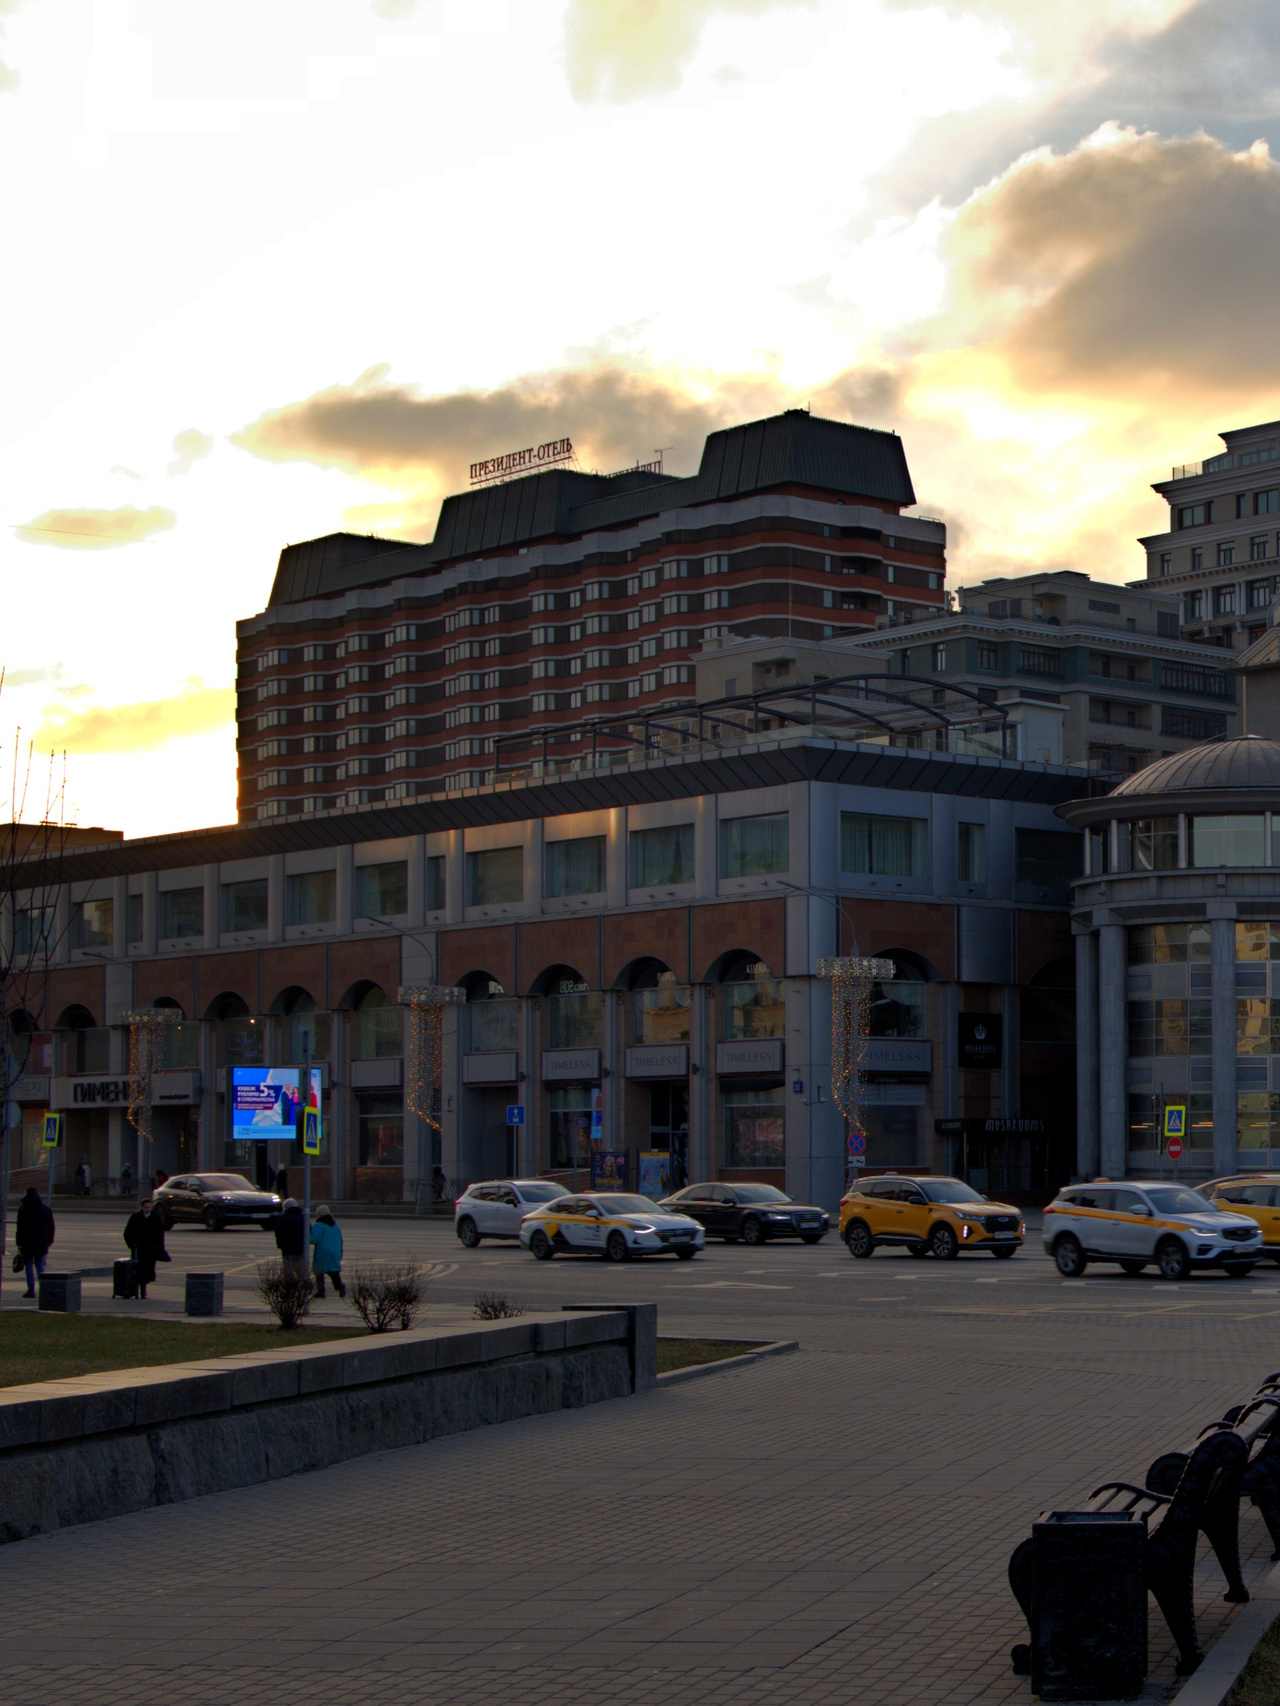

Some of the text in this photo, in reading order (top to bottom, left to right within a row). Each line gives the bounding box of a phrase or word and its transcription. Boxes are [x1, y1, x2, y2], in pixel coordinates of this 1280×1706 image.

[470, 437, 573, 479] ПРЕЗИДЕНТ-ОТЕЛЬ
[574, 982, 590, 992] cash
[633, 1056, 678, 1067] TIMELESS
[724, 1051, 773, 1063] TIMELESS
[549, 1059, 591, 1070] TIMELESS
[984, 1118, 1045, 1133] MUSHROOMS
